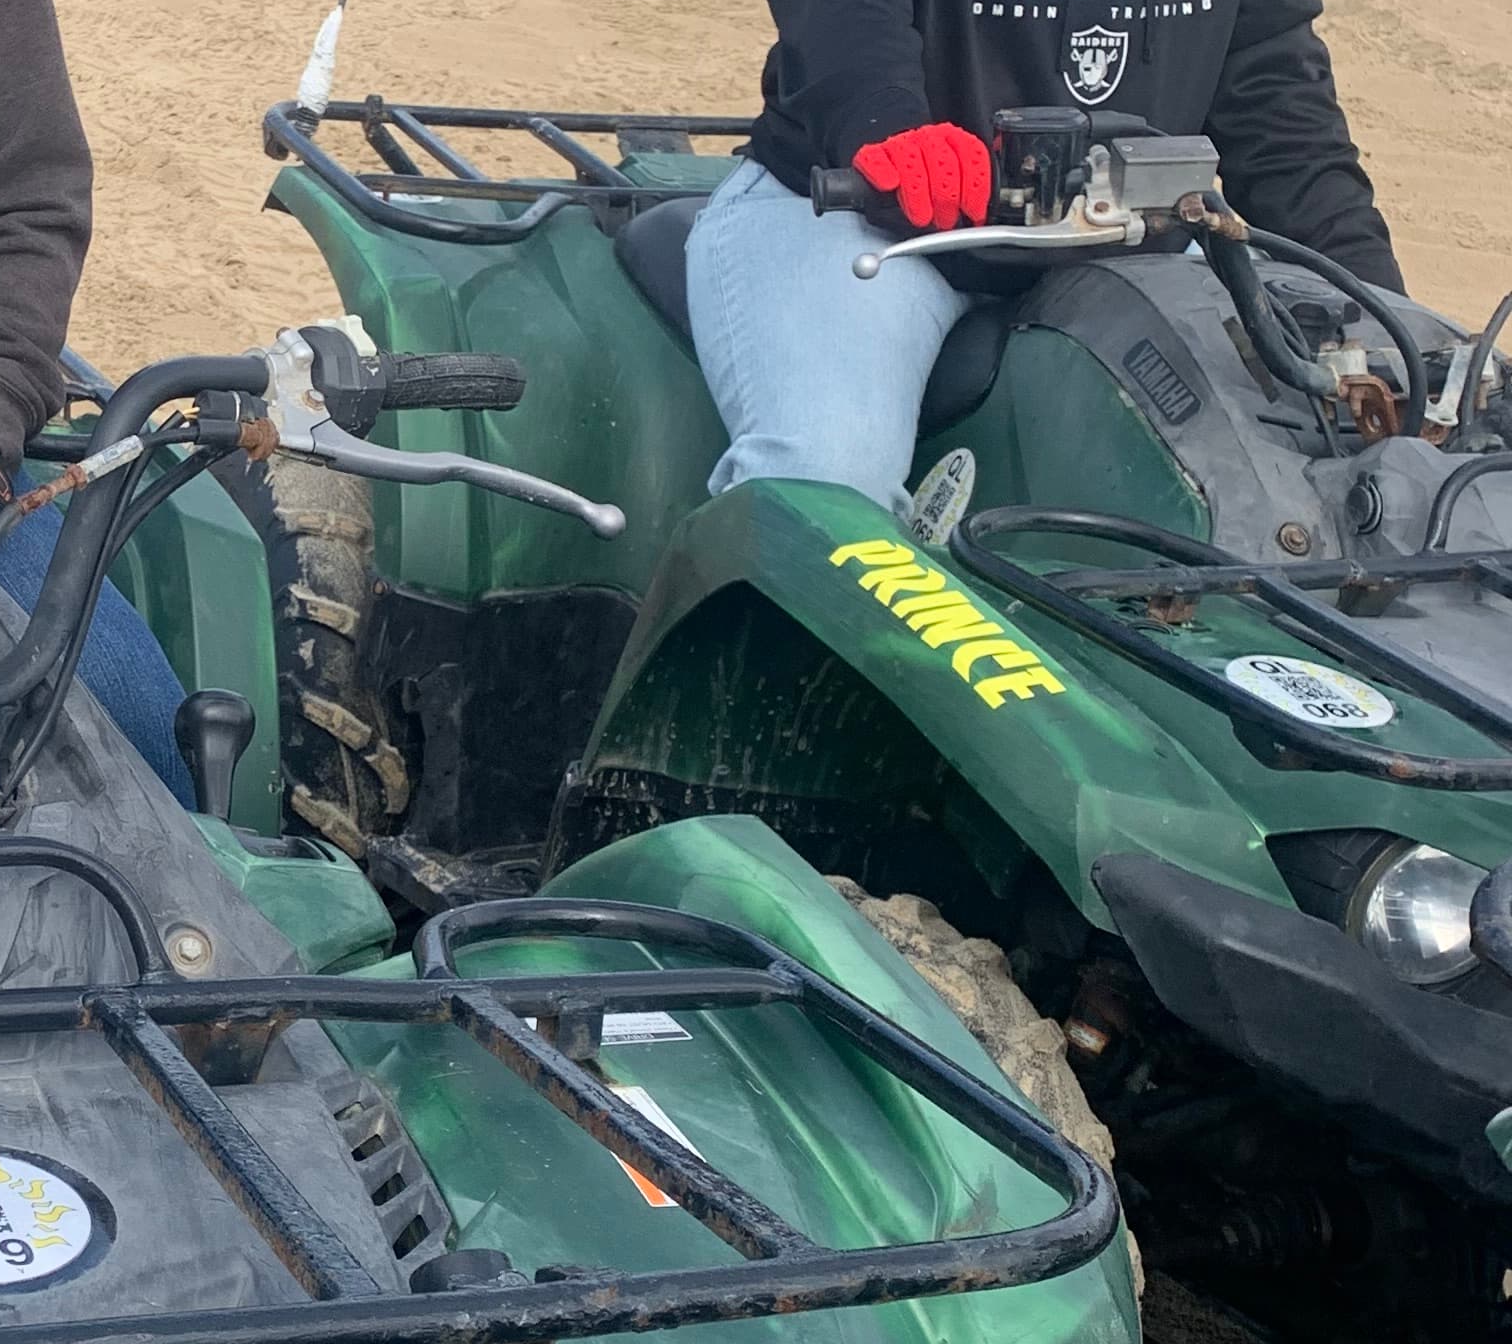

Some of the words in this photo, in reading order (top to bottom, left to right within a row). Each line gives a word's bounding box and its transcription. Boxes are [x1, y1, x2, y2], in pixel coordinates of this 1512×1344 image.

[1129, 343, 1196, 421] YAMAHA
[828, 539, 1067, 710] PRINCE
[1249, 660, 1307, 675] QL
[1302, 703, 1369, 718] 068
